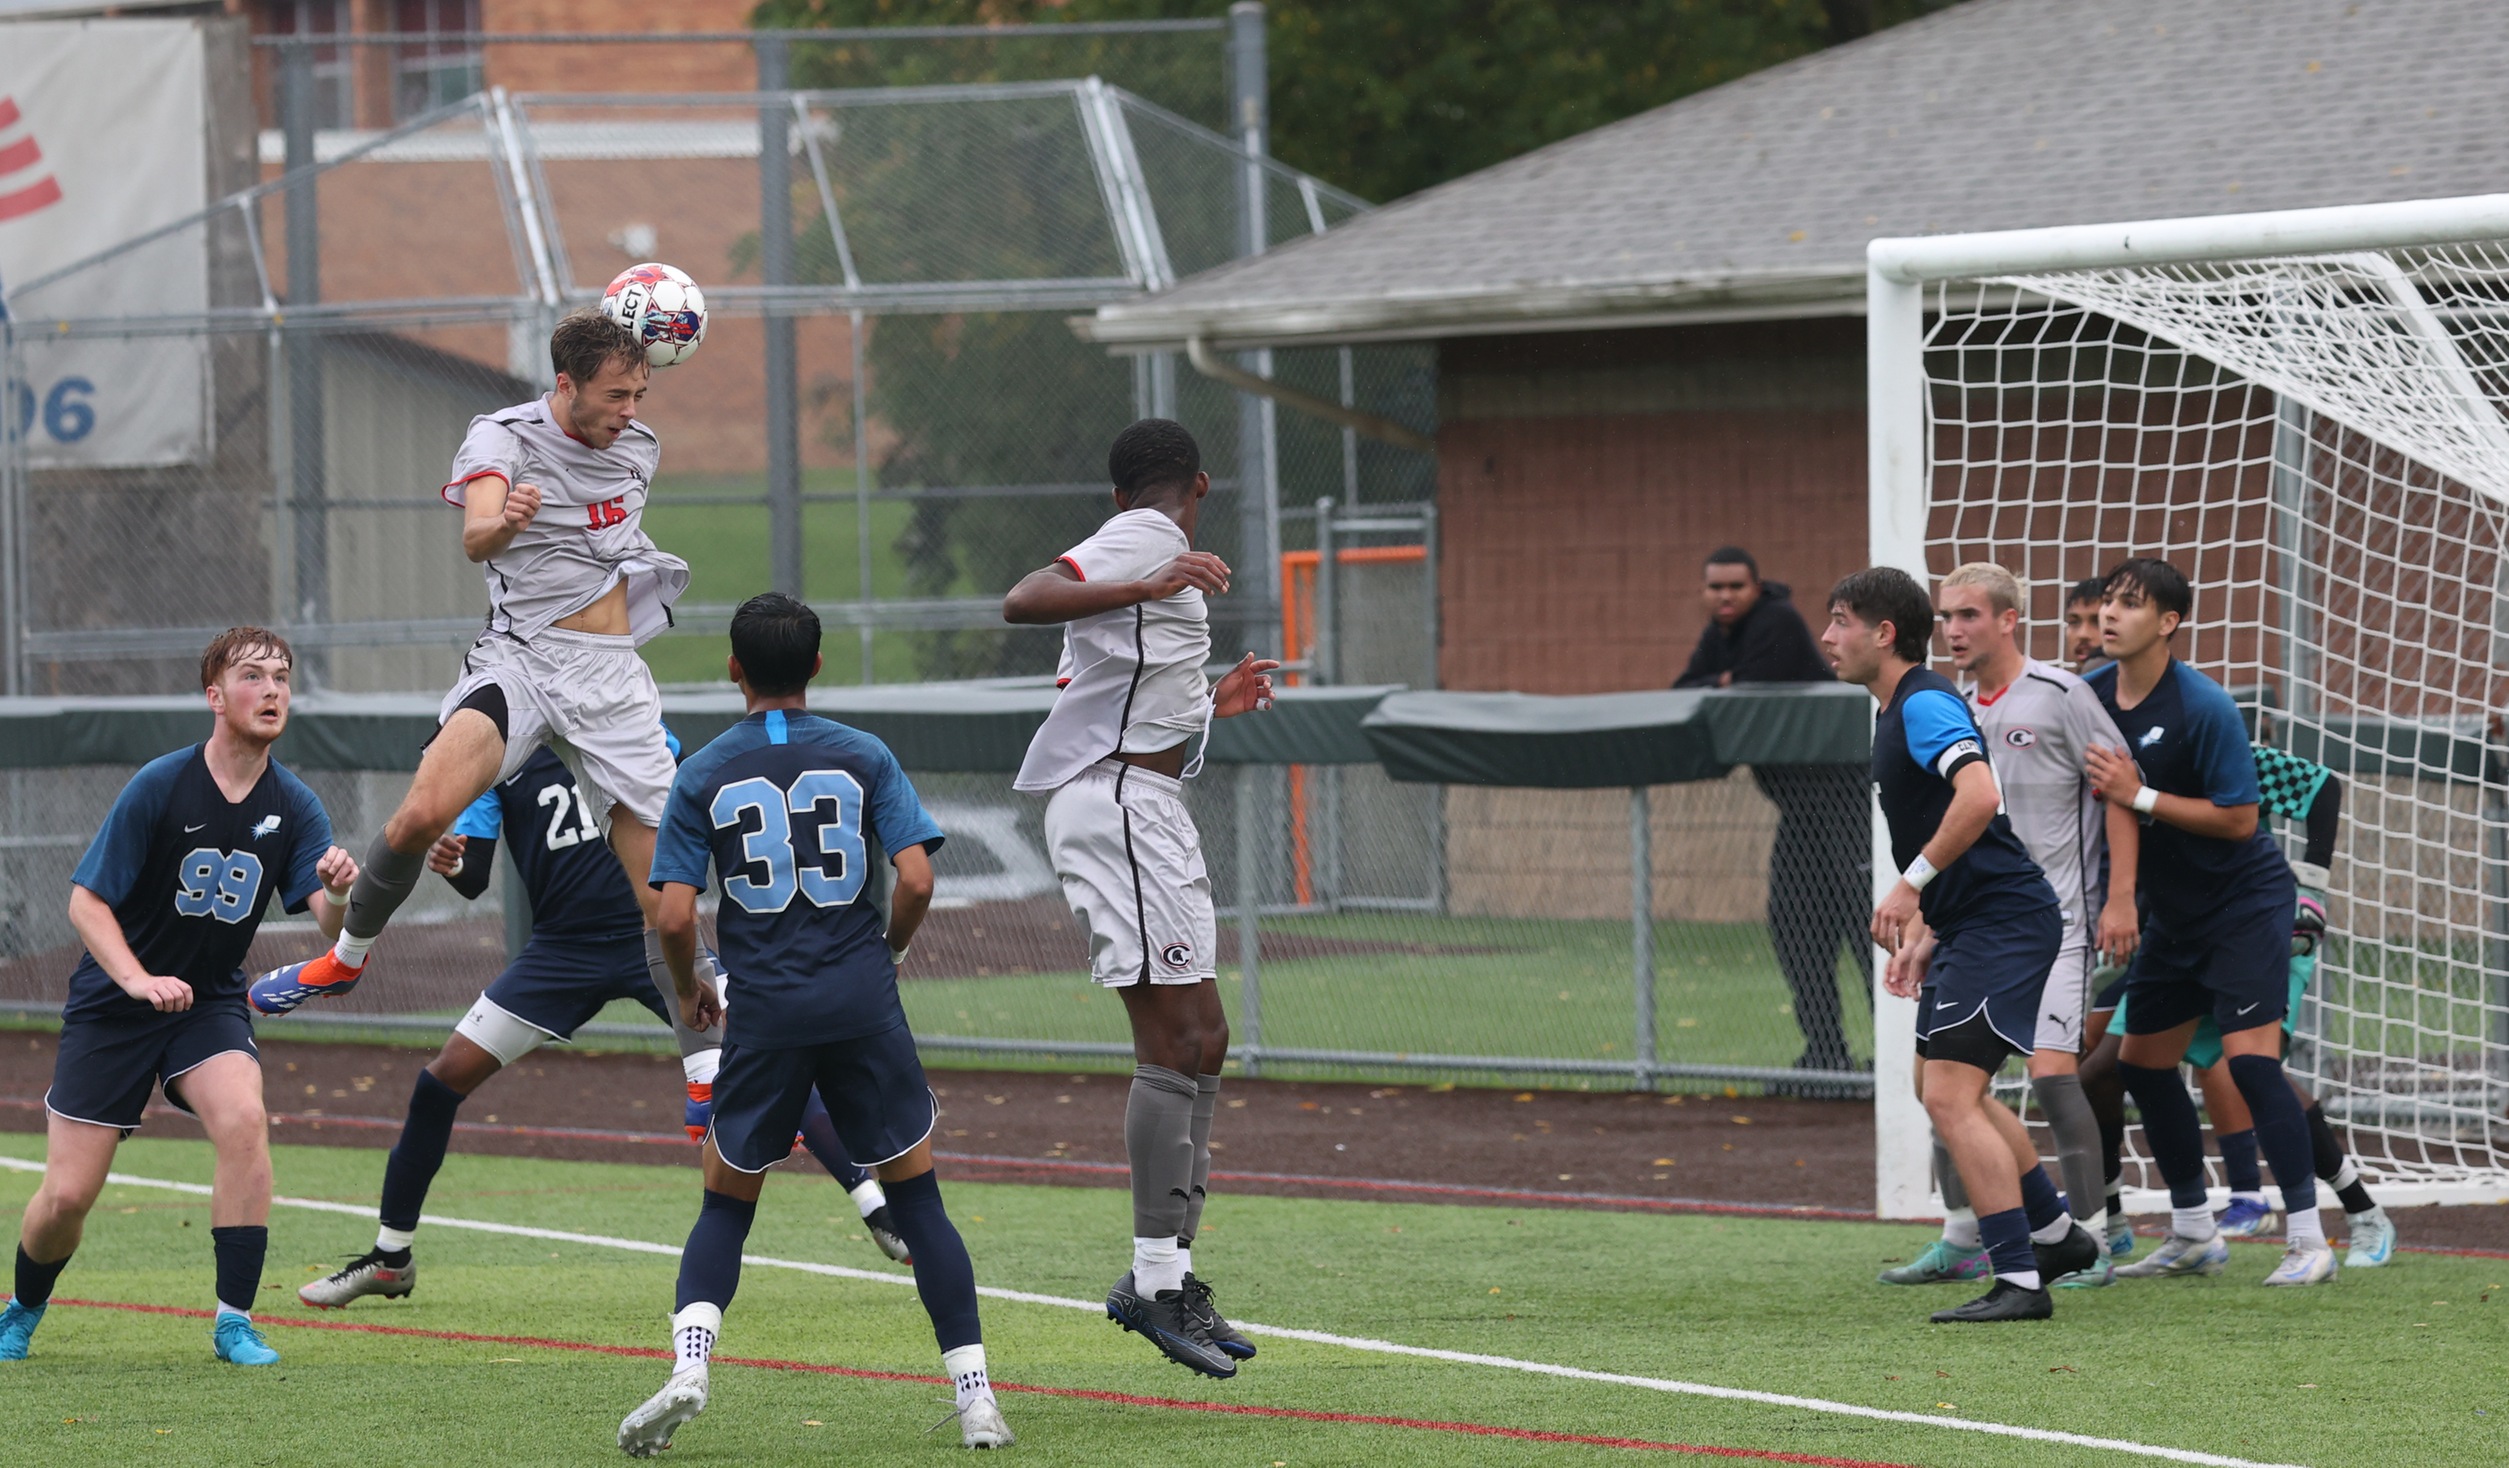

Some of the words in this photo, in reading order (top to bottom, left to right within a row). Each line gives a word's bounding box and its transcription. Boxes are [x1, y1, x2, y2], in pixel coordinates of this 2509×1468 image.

[621, 289, 642, 332] LECT
[586, 495, 627, 531] 16
[537, 783, 601, 852] 21
[709, 769, 867, 914] 33
[174, 847, 264, 924] 99
